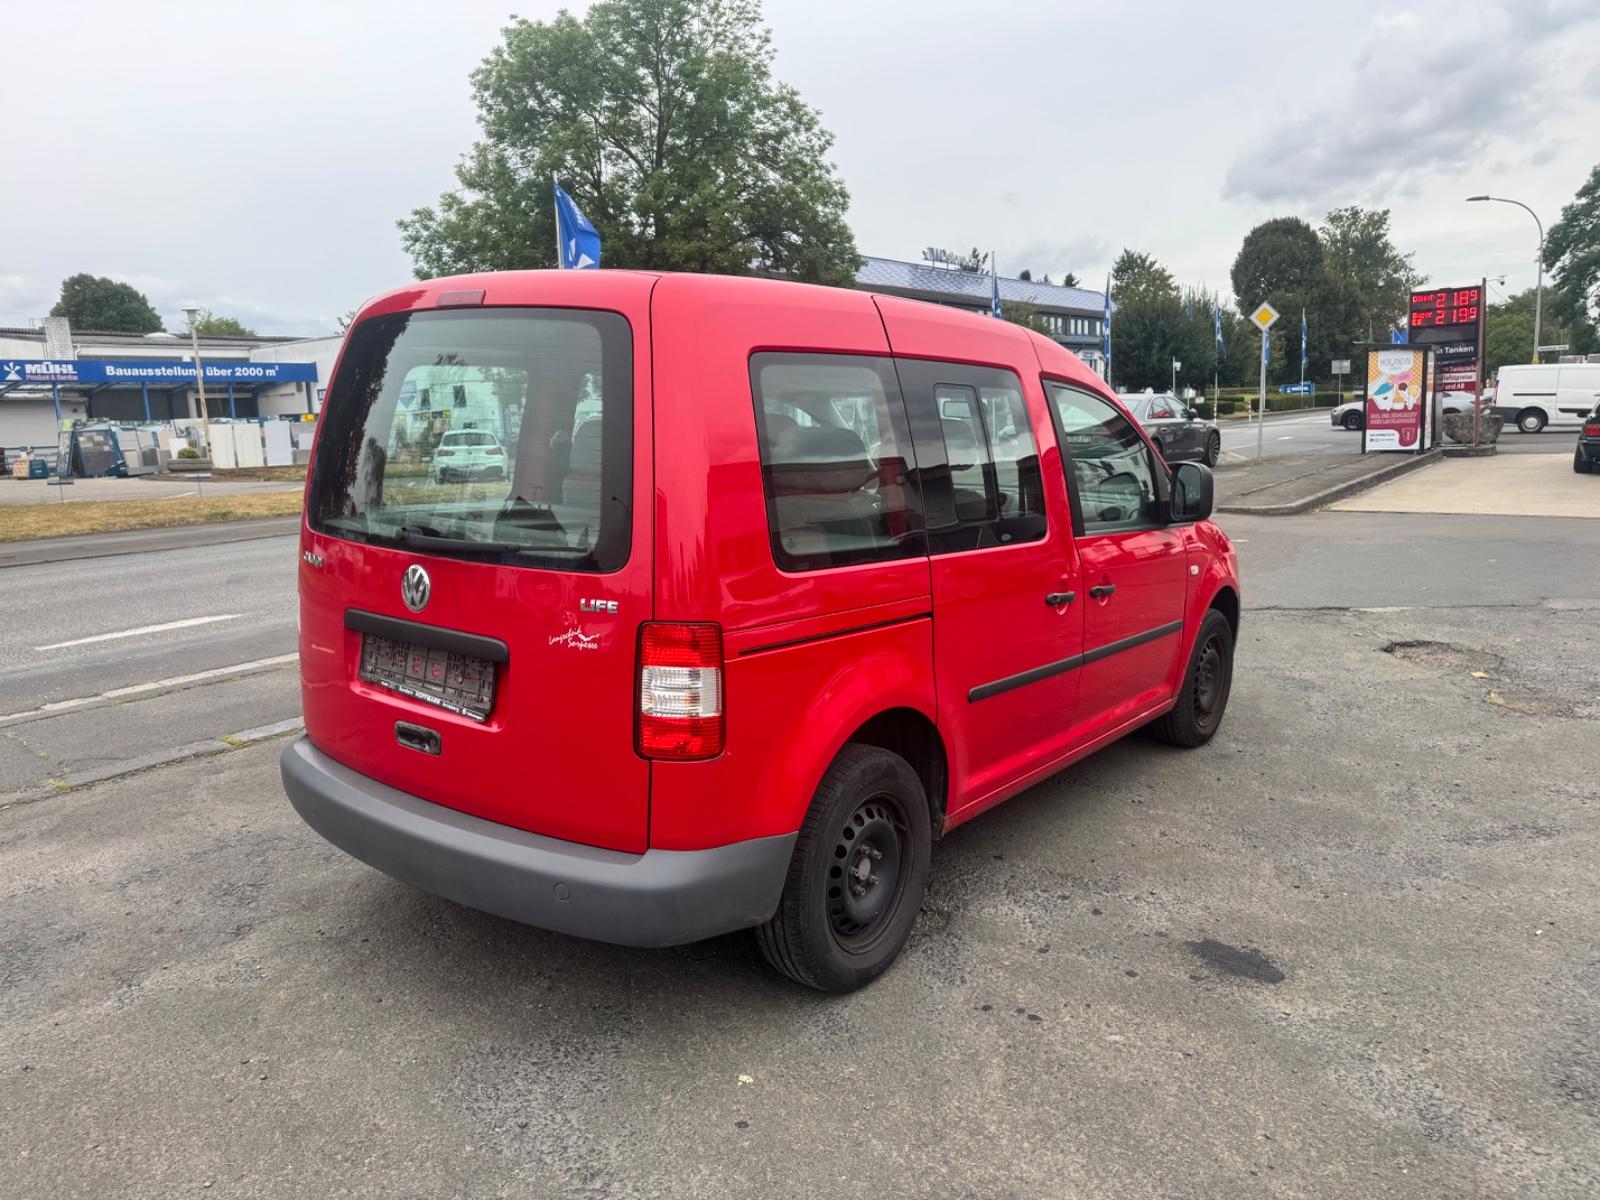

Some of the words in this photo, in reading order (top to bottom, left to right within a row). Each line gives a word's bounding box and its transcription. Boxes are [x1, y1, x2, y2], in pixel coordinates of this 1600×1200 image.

[1412, 312, 1432, 320] Super
[1444, 345, 1474, 353] Tanken
[25, 361, 78, 374] MÜHL
[205, 366, 232, 376] über
[234, 366, 263, 377] 2000
[580, 598, 619, 614] LIFE
